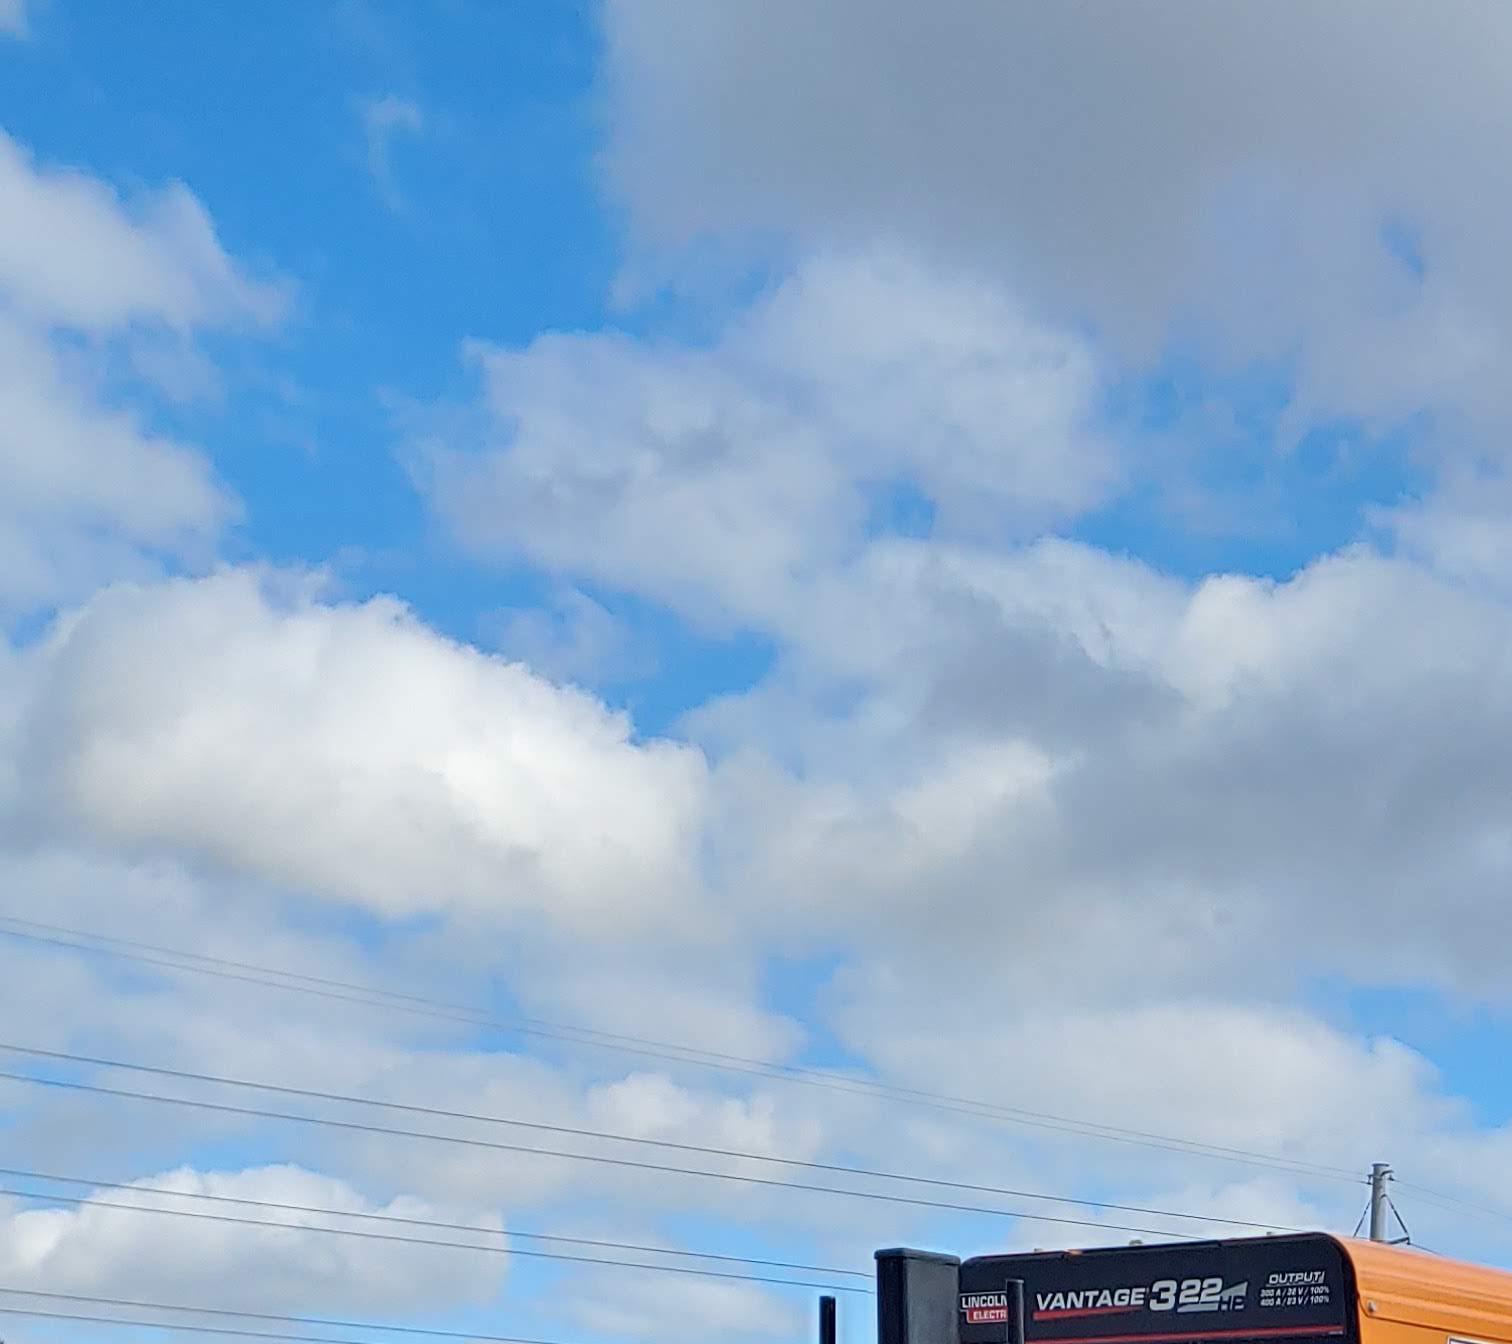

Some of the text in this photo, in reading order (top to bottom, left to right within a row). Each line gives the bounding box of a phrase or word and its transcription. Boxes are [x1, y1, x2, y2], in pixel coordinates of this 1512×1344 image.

[1268, 1271, 1322, 1284] OUTPUT
[1036, 1277, 1223, 1311] VANTAGE 322
[973, 1310, 1008, 1321] ELECTR
